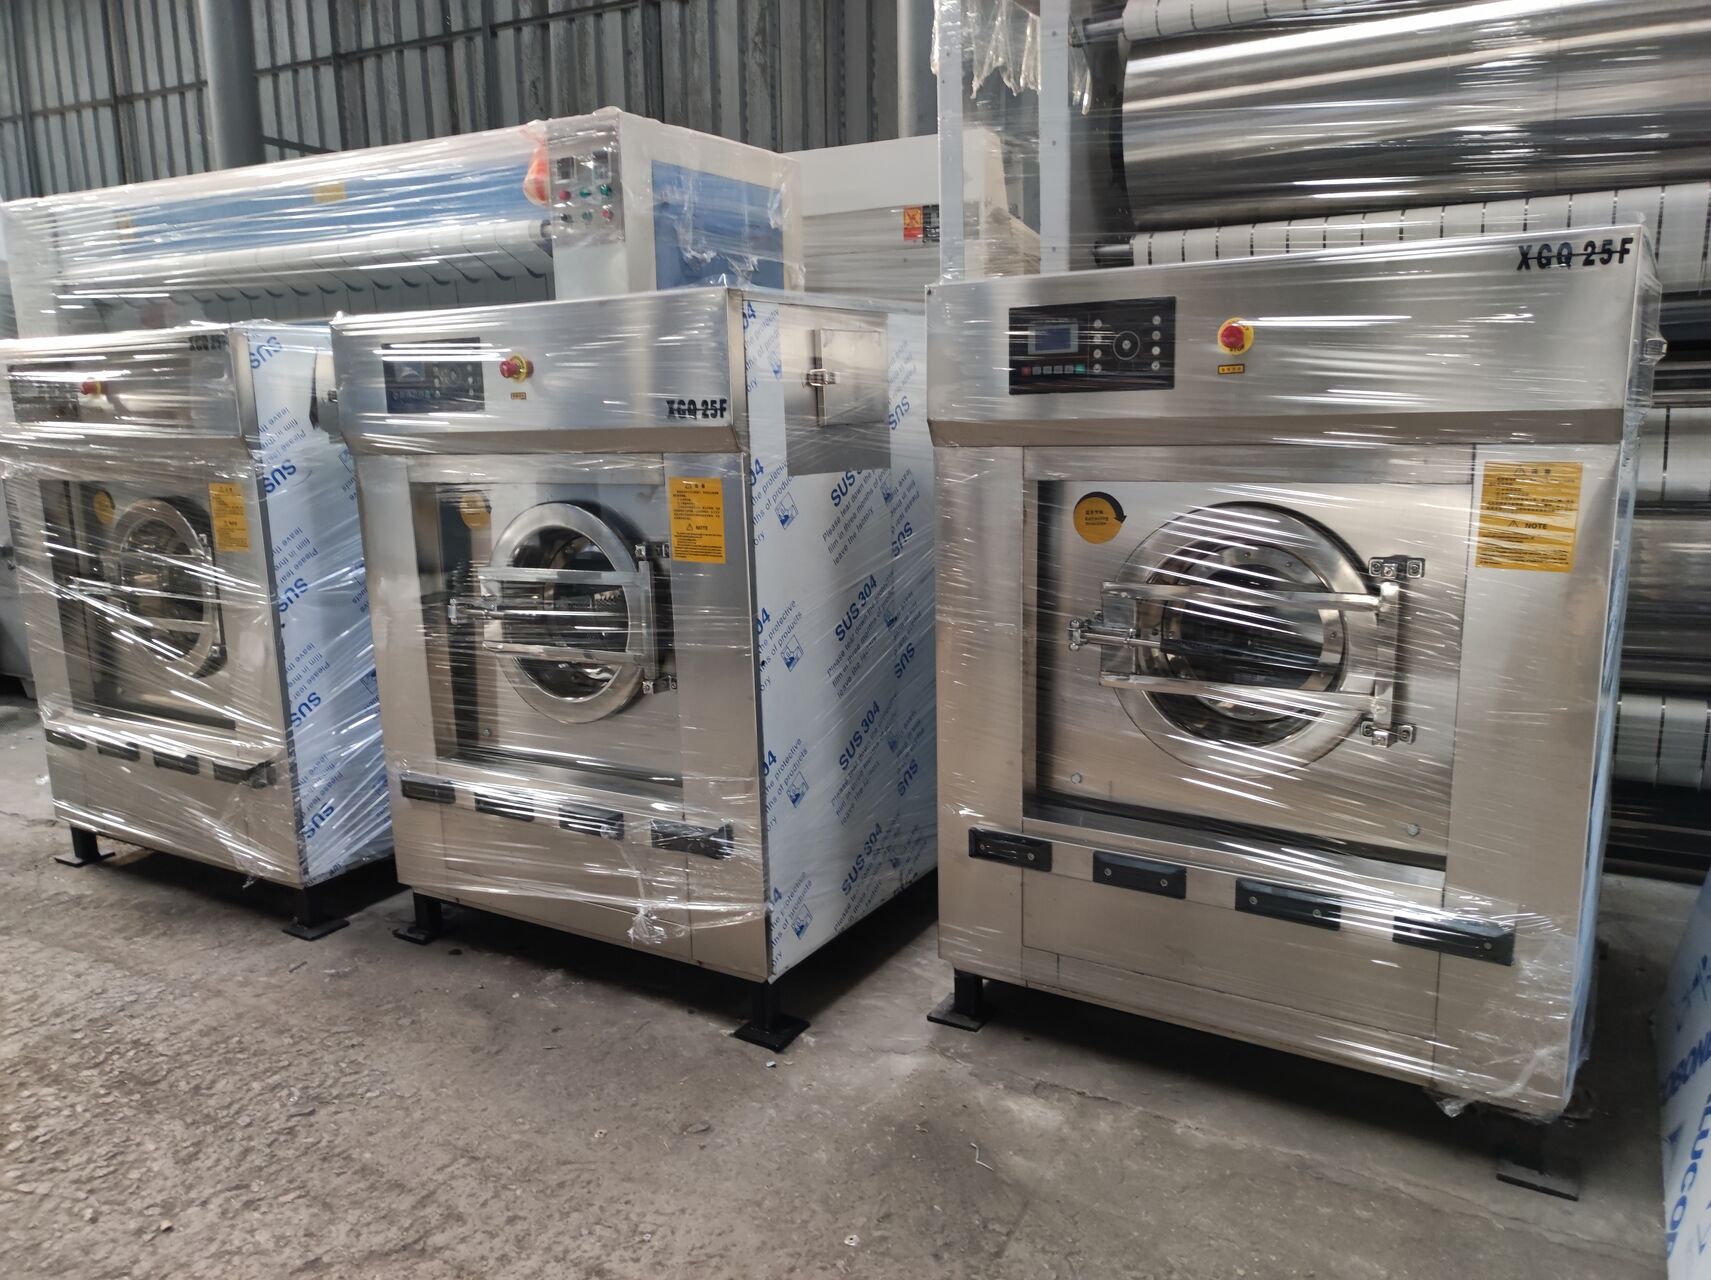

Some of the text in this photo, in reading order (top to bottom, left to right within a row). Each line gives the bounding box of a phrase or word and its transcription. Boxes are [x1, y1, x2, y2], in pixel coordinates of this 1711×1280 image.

[1517, 237, 1634, 270] XGQ 25F
[666, 399, 728, 419] XGQ 25F
[888, 396, 909, 429] SUS
[263, 460, 296, 491] SUS
[831, 471, 856, 507] SUS
[765, 500, 772, 511] of
[823, 516, 841, 541] Please
[892, 522, 912, 554] SUS
[1525, 522, 1548, 530] NOTE
[828, 538, 839, 553] film
[835, 545, 850, 566] leave
[769, 599, 797, 641] protective
[835, 575, 877, 641] SUS 304
[771, 645, 778, 656] of
[778, 611, 802, 647] products
[295, 642, 314, 663] leave
[895, 643, 914, 676] SUS
[302, 665, 309, 674] in
[308, 662, 329, 685] Please
[291, 692, 321, 724] SUS
[839, 701, 880, 770] SUS 304
[774, 738, 802, 779] protective
[777, 785, 784, 795] of
[784, 748, 808, 786] products
[897, 760, 917, 794] SUS
[842, 855, 865, 895] SUS
[782, 919, 789, 930] of
